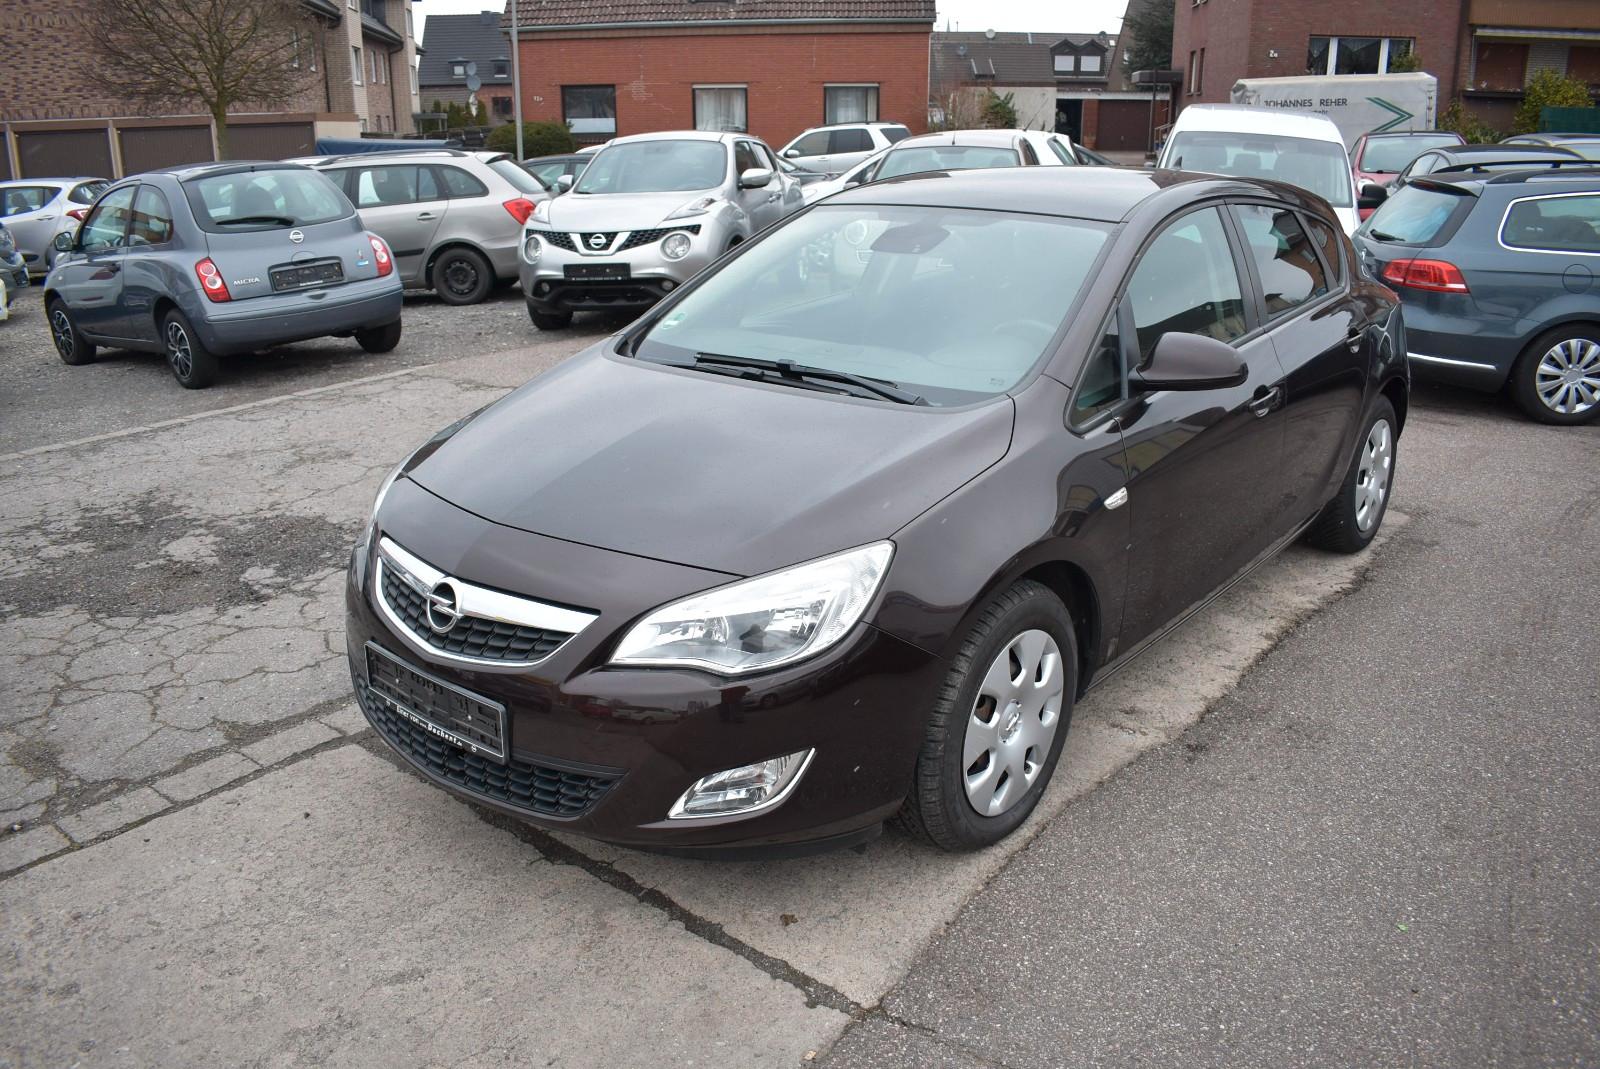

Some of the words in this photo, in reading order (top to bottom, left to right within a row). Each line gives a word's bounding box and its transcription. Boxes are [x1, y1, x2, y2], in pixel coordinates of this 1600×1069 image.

[1264, 98, 1313, 108] JOHANNES
[1319, 98, 1348, 107] REHER
[233, 277, 261, 285] MICRA
